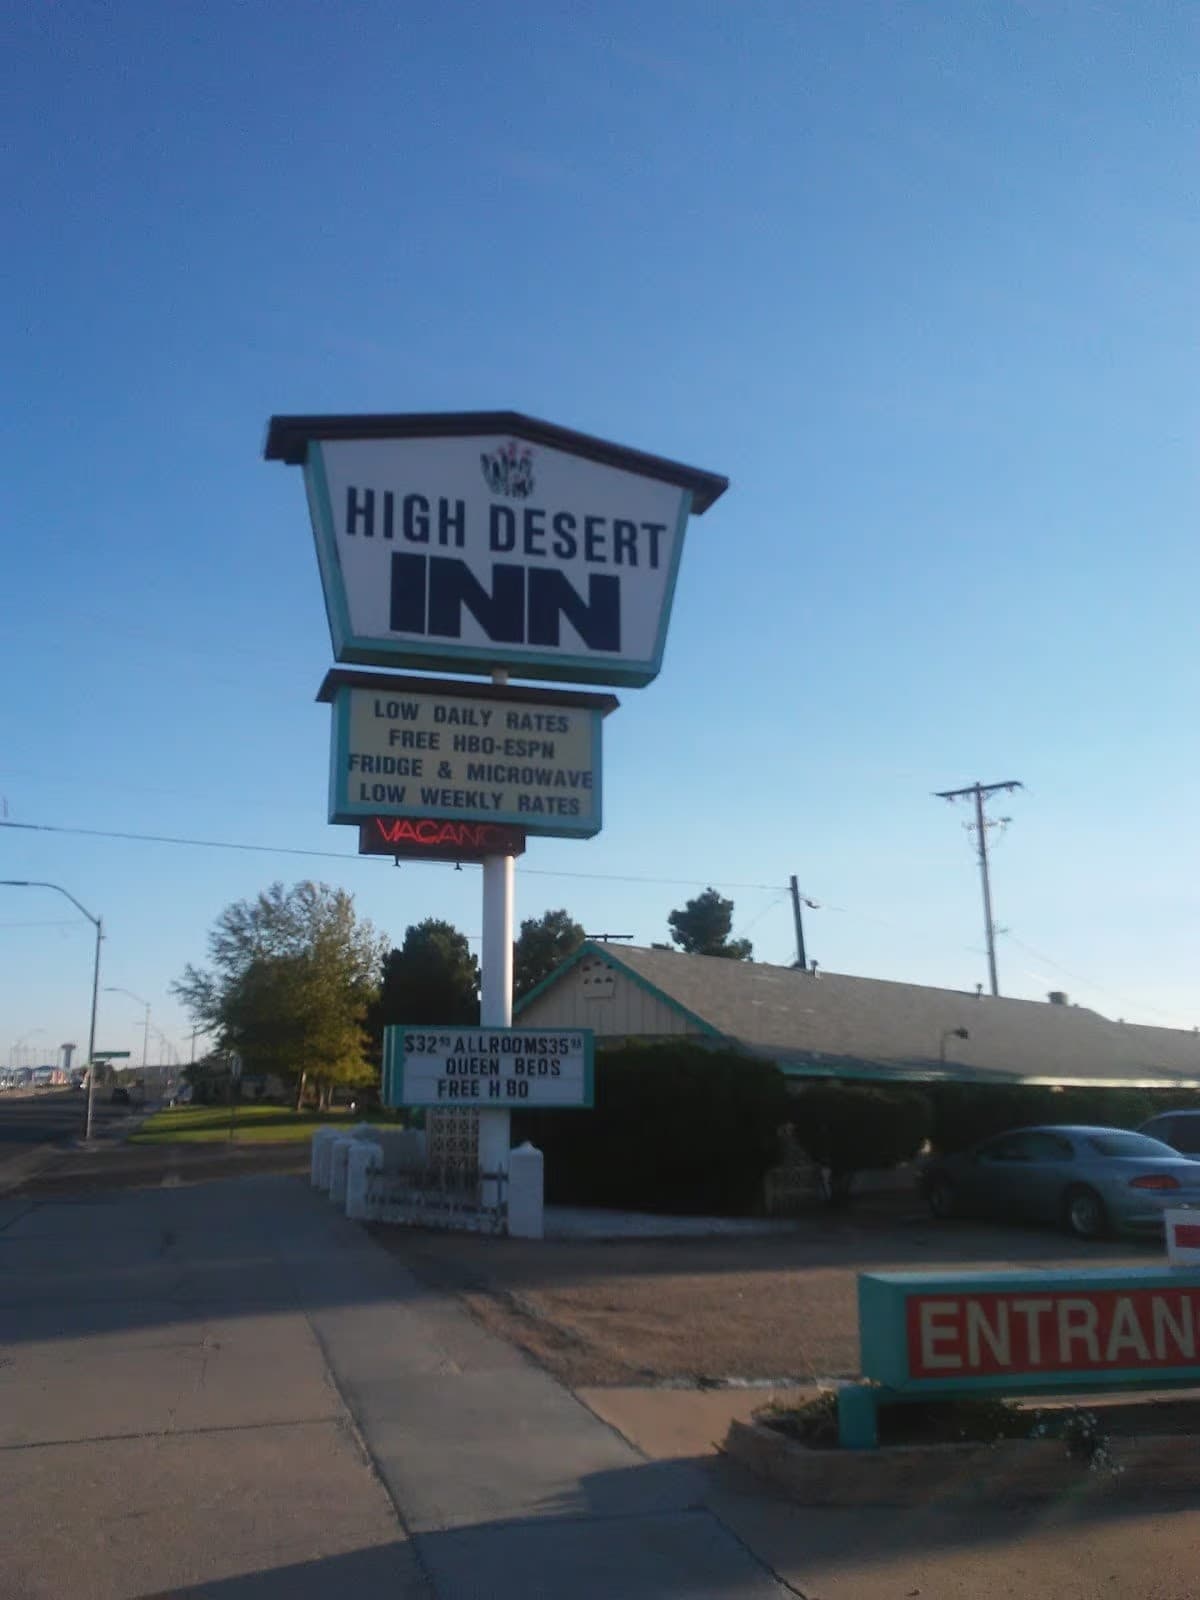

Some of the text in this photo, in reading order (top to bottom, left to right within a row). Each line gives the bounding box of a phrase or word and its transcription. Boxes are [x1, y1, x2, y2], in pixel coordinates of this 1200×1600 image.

[346, 486, 667, 569] HIGH DESERT
[390, 551, 621, 652] INN
[374, 699, 569, 734] LOW DAILY RATES
[389, 728, 555, 759] FREE HBO-ESPN
[348, 753, 593, 789] FRIDGE & MICROWAVE
[360, 783, 580, 815] LOW WEEKLY RATES
[446, 1057, 561, 1076] QUEEN BEDS
[437, 1079, 480, 1098] FREE
[919, 1295, 1200, 1369] ENTRAN
